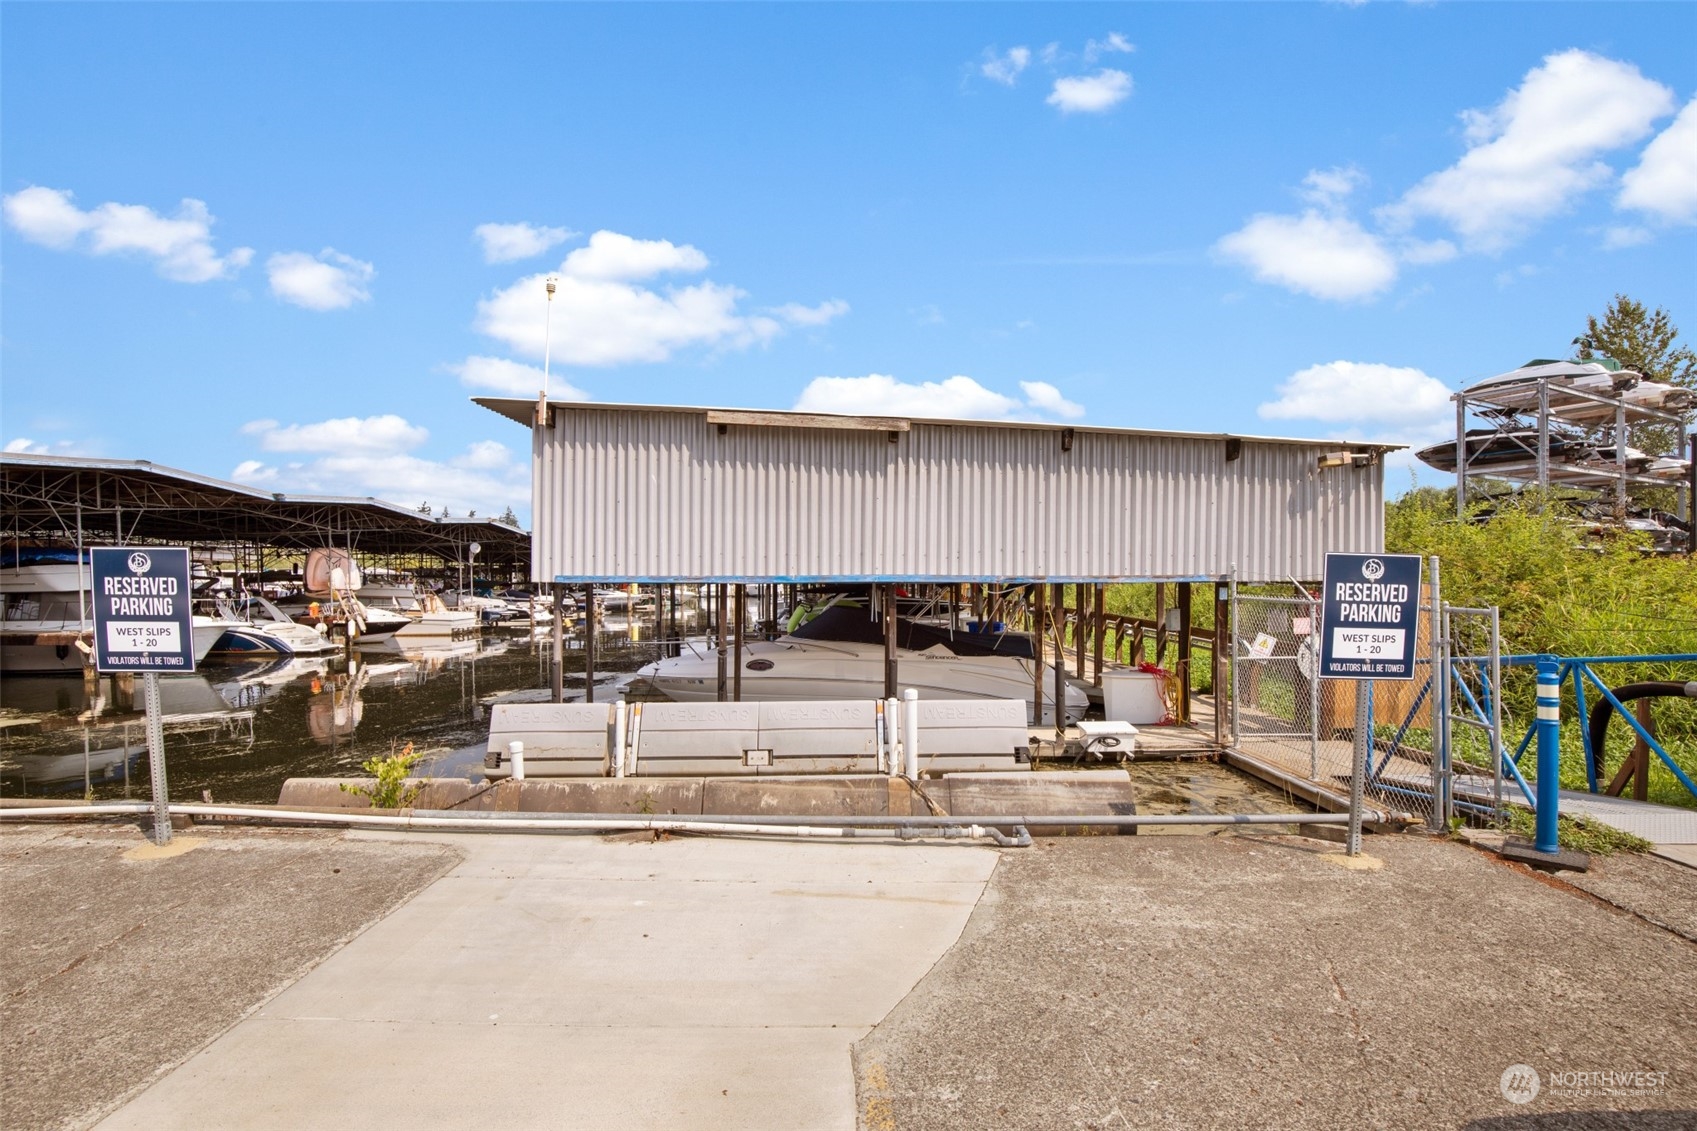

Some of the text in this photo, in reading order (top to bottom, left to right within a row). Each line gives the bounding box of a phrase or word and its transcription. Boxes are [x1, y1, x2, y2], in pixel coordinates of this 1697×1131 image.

[104, 577, 178, 596] RESERVED
[1335, 582, 1408, 602] RESERVED
[111, 597, 173, 616] PARKING
[1340, 603, 1402, 623] PARKING
[116, 627, 171, 636] WEST SLIPS
[1342, 634, 1396, 643] WEST SLIPS
[132, 639, 138, 647] 1
[146, 639, 157, 647] 20
[1356, 645, 1361, 653] 1
[1370, 645, 1381, 654] 20
[107, 656, 184, 665] VIOLATORS WILL BE TOWED
[1329, 663, 1405, 673] VIOLATORS WILL BE TOWED
[499, 710, 594, 725] SUNSTREAM
[655, 709, 750, 723] SUNSTREAM
[767, 707, 863, 721] SUNSTREAM
[923, 706, 1018, 720] SUNSTREAM
